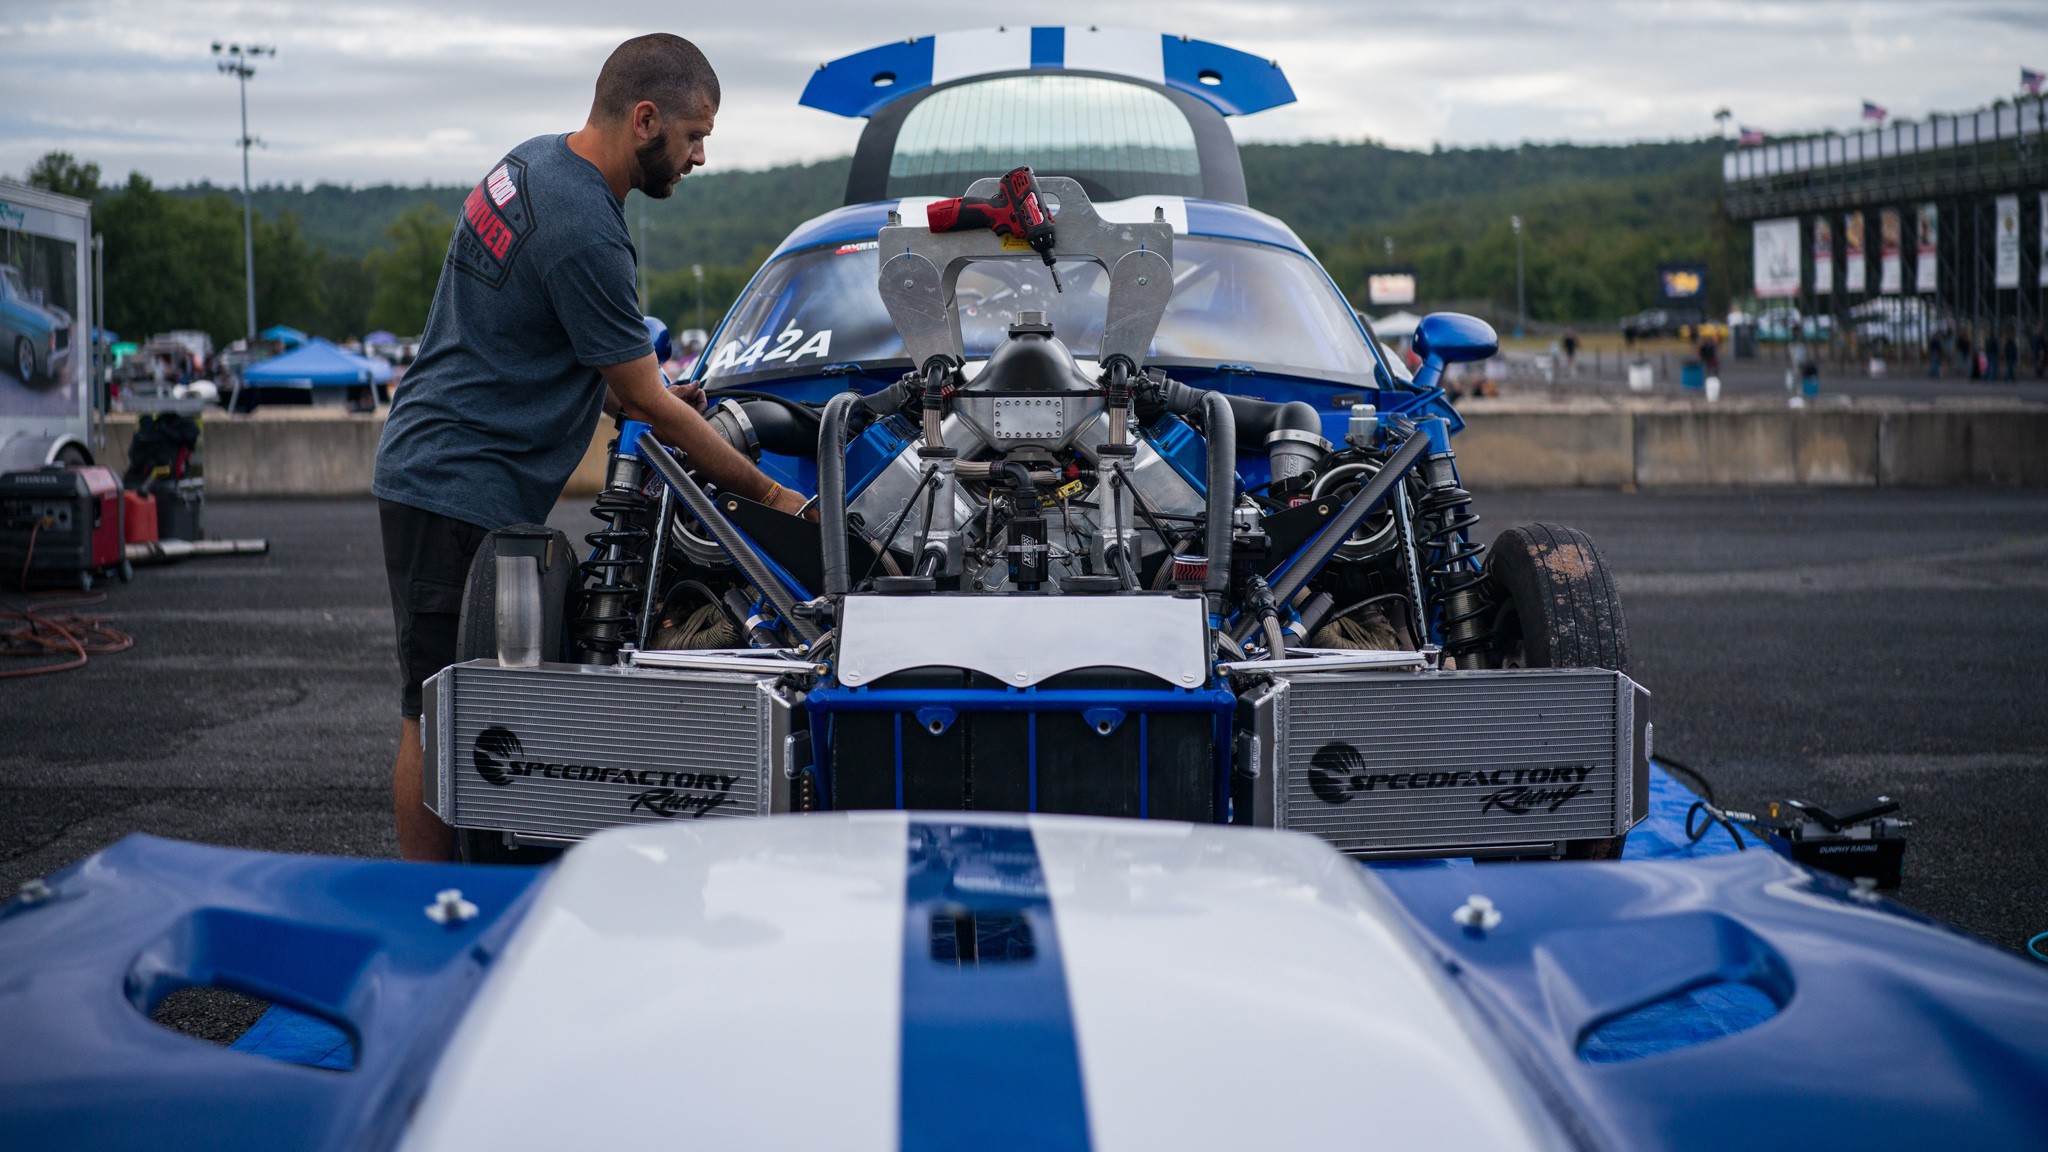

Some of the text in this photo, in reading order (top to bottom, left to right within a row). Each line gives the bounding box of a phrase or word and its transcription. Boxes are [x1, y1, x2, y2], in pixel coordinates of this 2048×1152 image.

[507, 760, 740, 792] SPEEDFACTORY
[1347, 764, 1596, 791] SPEEDFACTORY
[627, 788, 739, 818] Racing
[1479, 784, 1594, 815] Racing
[1819, 844, 1878, 854] DUNPHY RACING
